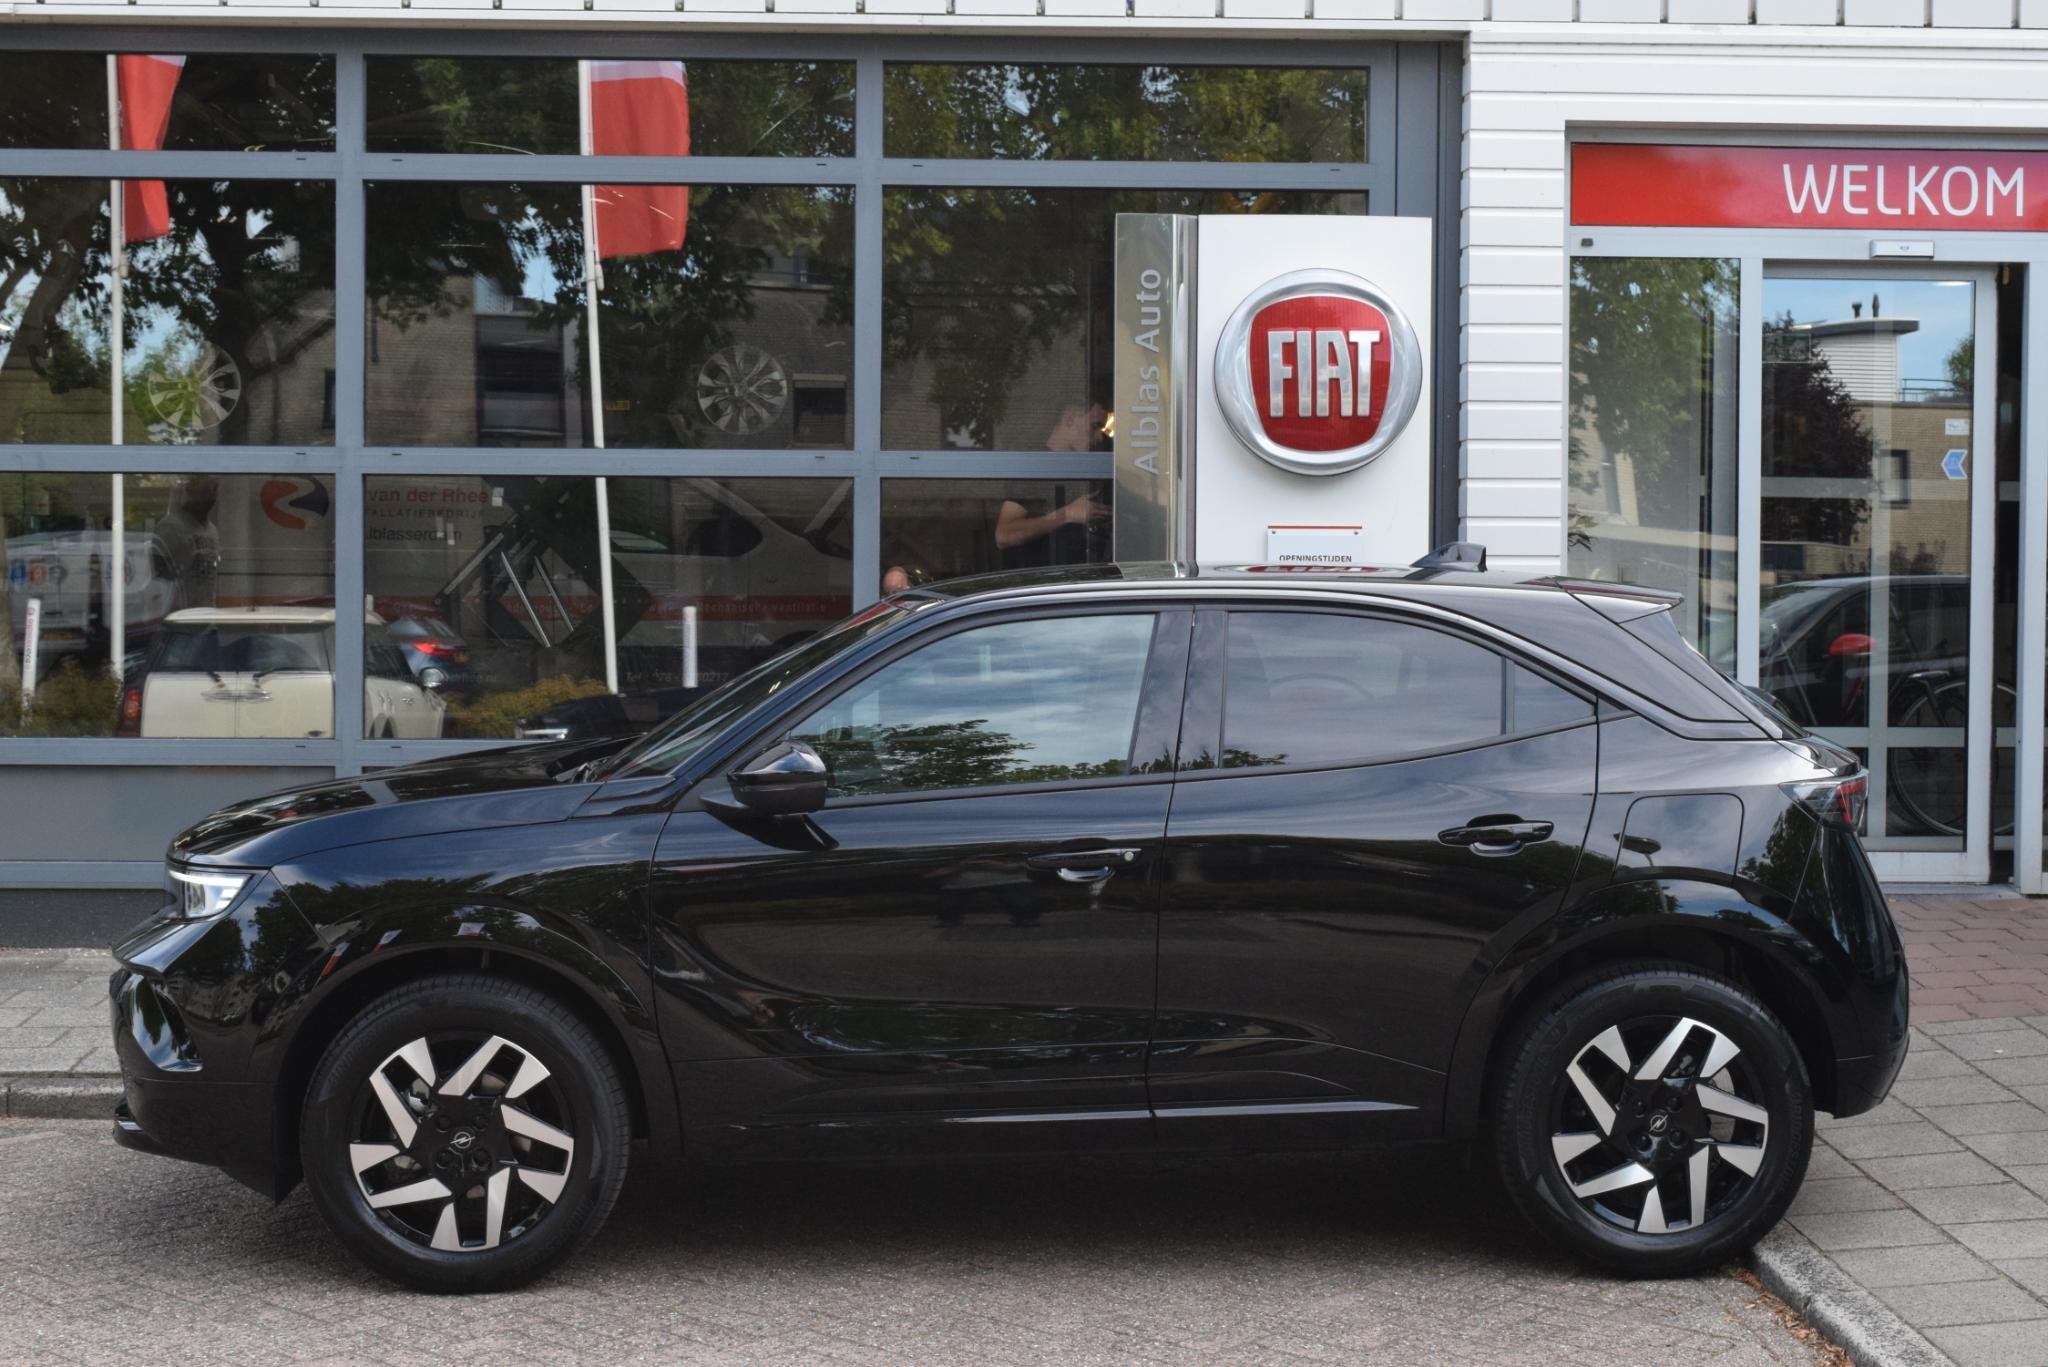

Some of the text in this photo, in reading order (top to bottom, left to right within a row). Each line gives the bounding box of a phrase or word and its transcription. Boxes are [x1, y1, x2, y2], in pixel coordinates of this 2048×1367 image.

[1782, 164, 2025, 216] WELKOM
[1133, 268, 1161, 474] Alblas Auto
[1267, 330, 1380, 417] FIAT
[368, 487, 488, 502] van der Rhee
[1279, 554, 1352, 562] OPENINGSTIJDEN
